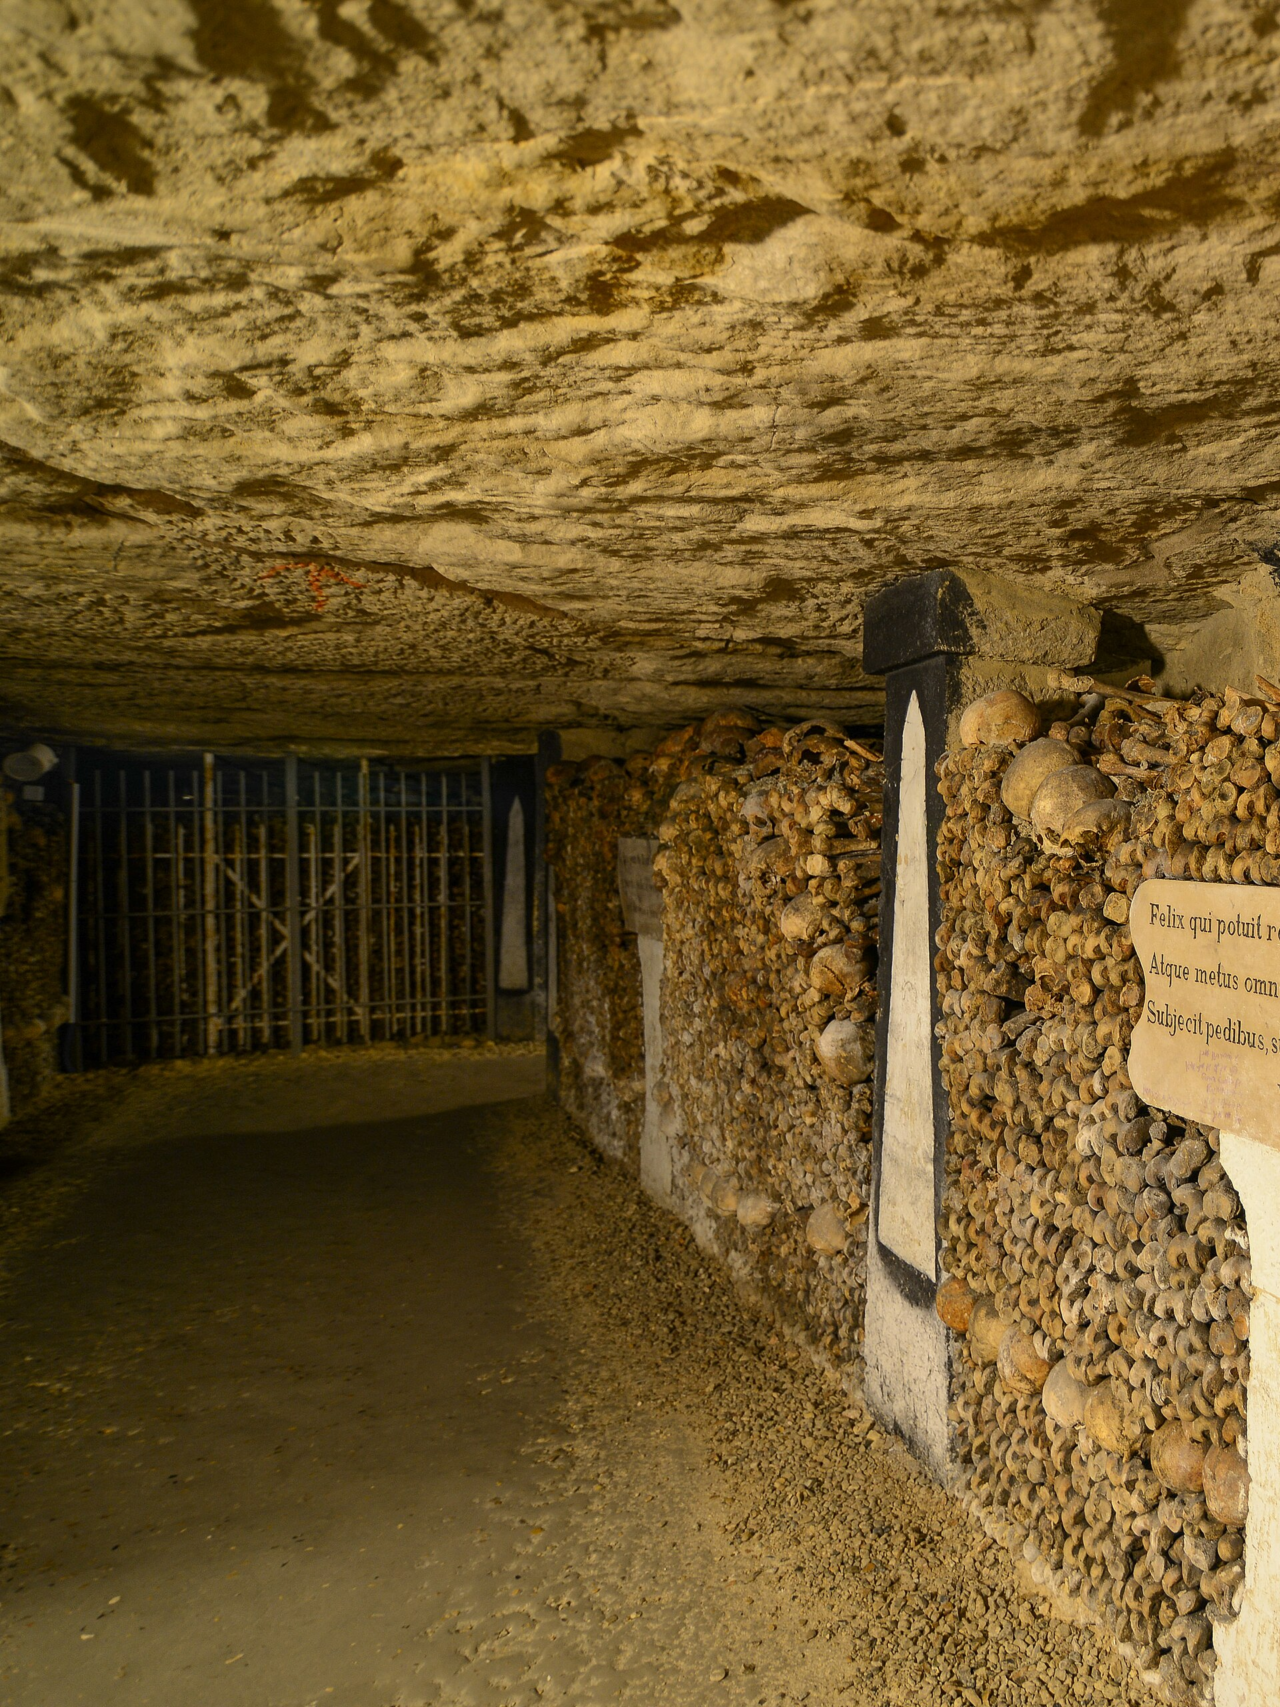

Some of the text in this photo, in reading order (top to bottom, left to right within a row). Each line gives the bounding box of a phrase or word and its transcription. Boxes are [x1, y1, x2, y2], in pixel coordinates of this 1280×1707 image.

[1149, 903, 1185, 929] Felix
[1189, 911, 1212, 940] qui
[1216, 913, 1263, 943] potuit
[1149, 951, 1190, 988] Atque
[1194, 962, 1239, 990] metus
[1146, 999, 1203, 1037] Subjecit
[1205, 1017, 1269, 1055] pedibus,
